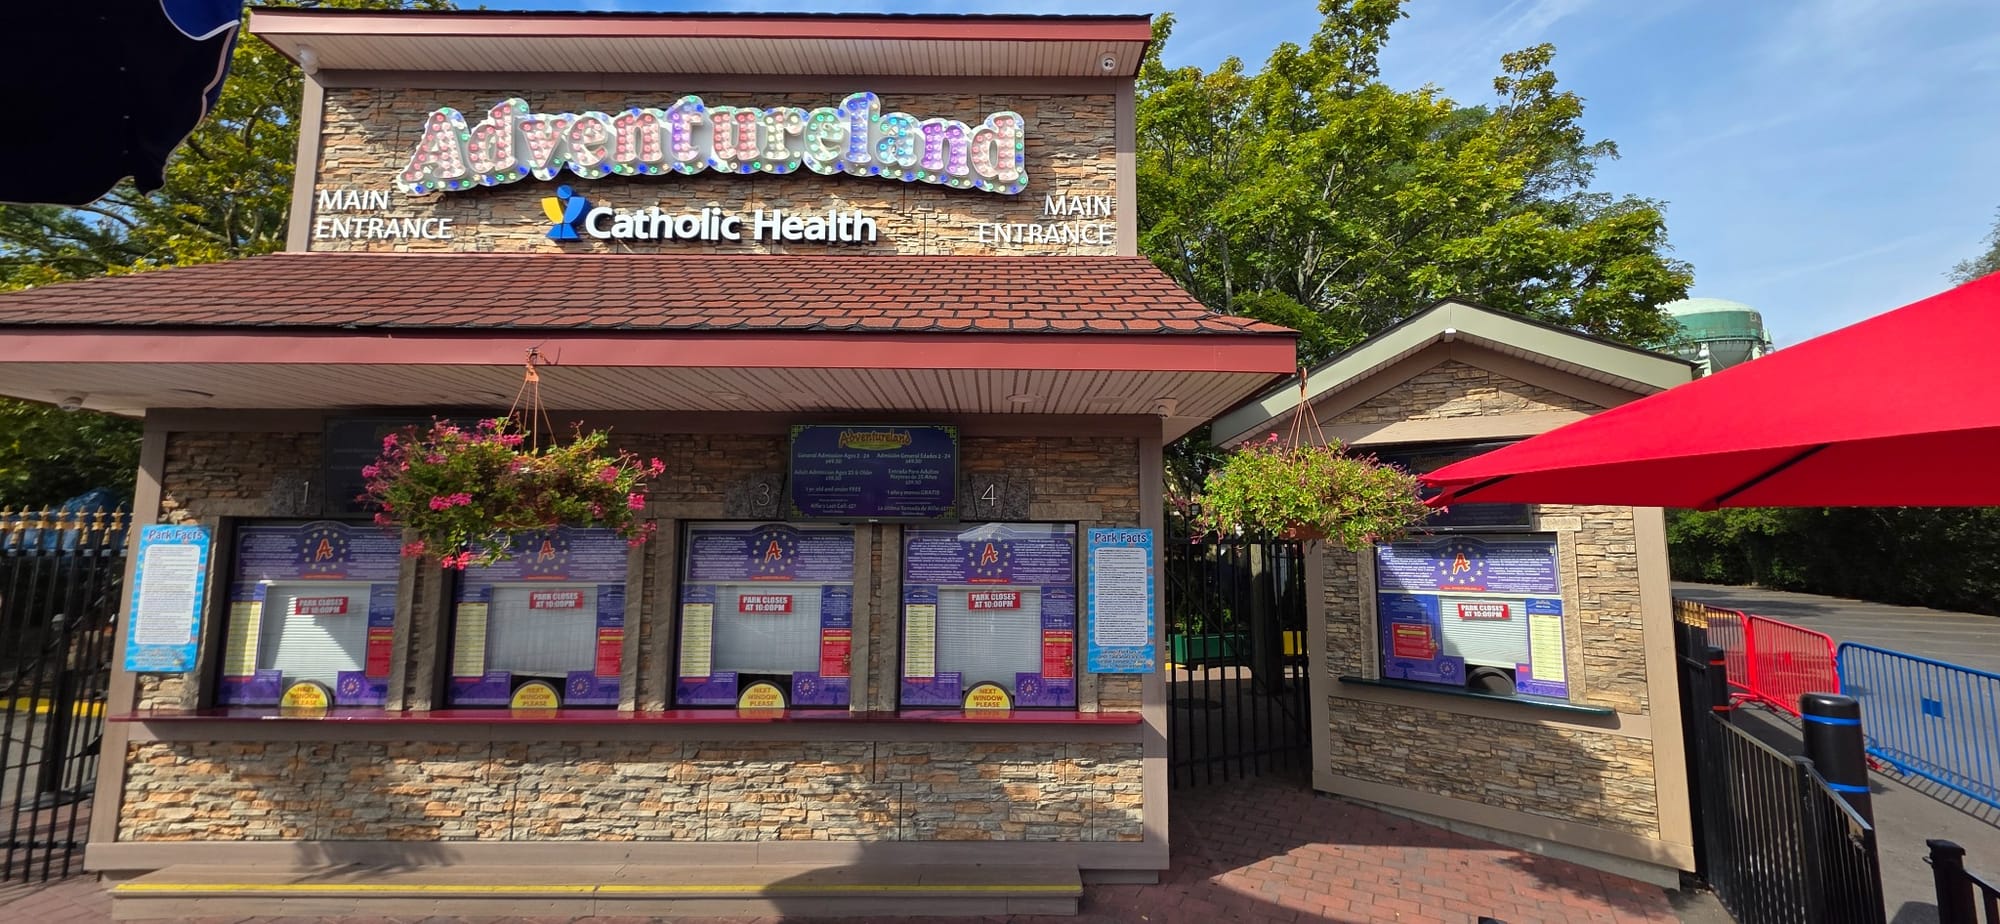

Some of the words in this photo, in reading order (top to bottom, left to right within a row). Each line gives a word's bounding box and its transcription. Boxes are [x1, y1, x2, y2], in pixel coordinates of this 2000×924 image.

[399, 93, 1025, 189] Adventureland
[318, 189, 389, 210] MAIN
[1044, 193, 1111, 216] MAIN
[315, 217, 454, 239] ENTRANCE
[585, 206, 741, 240] Catholic
[753, 208, 877, 242] Health
[979, 222, 1114, 245] ENTRANCE
[838, 428, 912, 448] Adventureland
[303, 481, 309, 504] 1
[756, 483, 769, 505] 3
[981, 483, 997, 507] 4
[148, 529, 172, 541] Park
[174, 529, 203, 541] Facts
[1094, 532, 1118, 544] Park
[1120, 532, 1147, 543] Facts
[318, 598, 344, 606] CLOSES
[533, 592, 551, 600] PARK
[552, 592, 578, 600] CLOSES
[535, 600, 544, 608] AT
[546, 600, 575, 608] 10:00PM
[743, 596, 761, 604] PARK
[762, 596, 788, 604] CLOSES
[971, 593, 990, 601] PARK
[990, 593, 1016, 601] CLOSES
[984, 600, 1014, 608] 10:00PM
